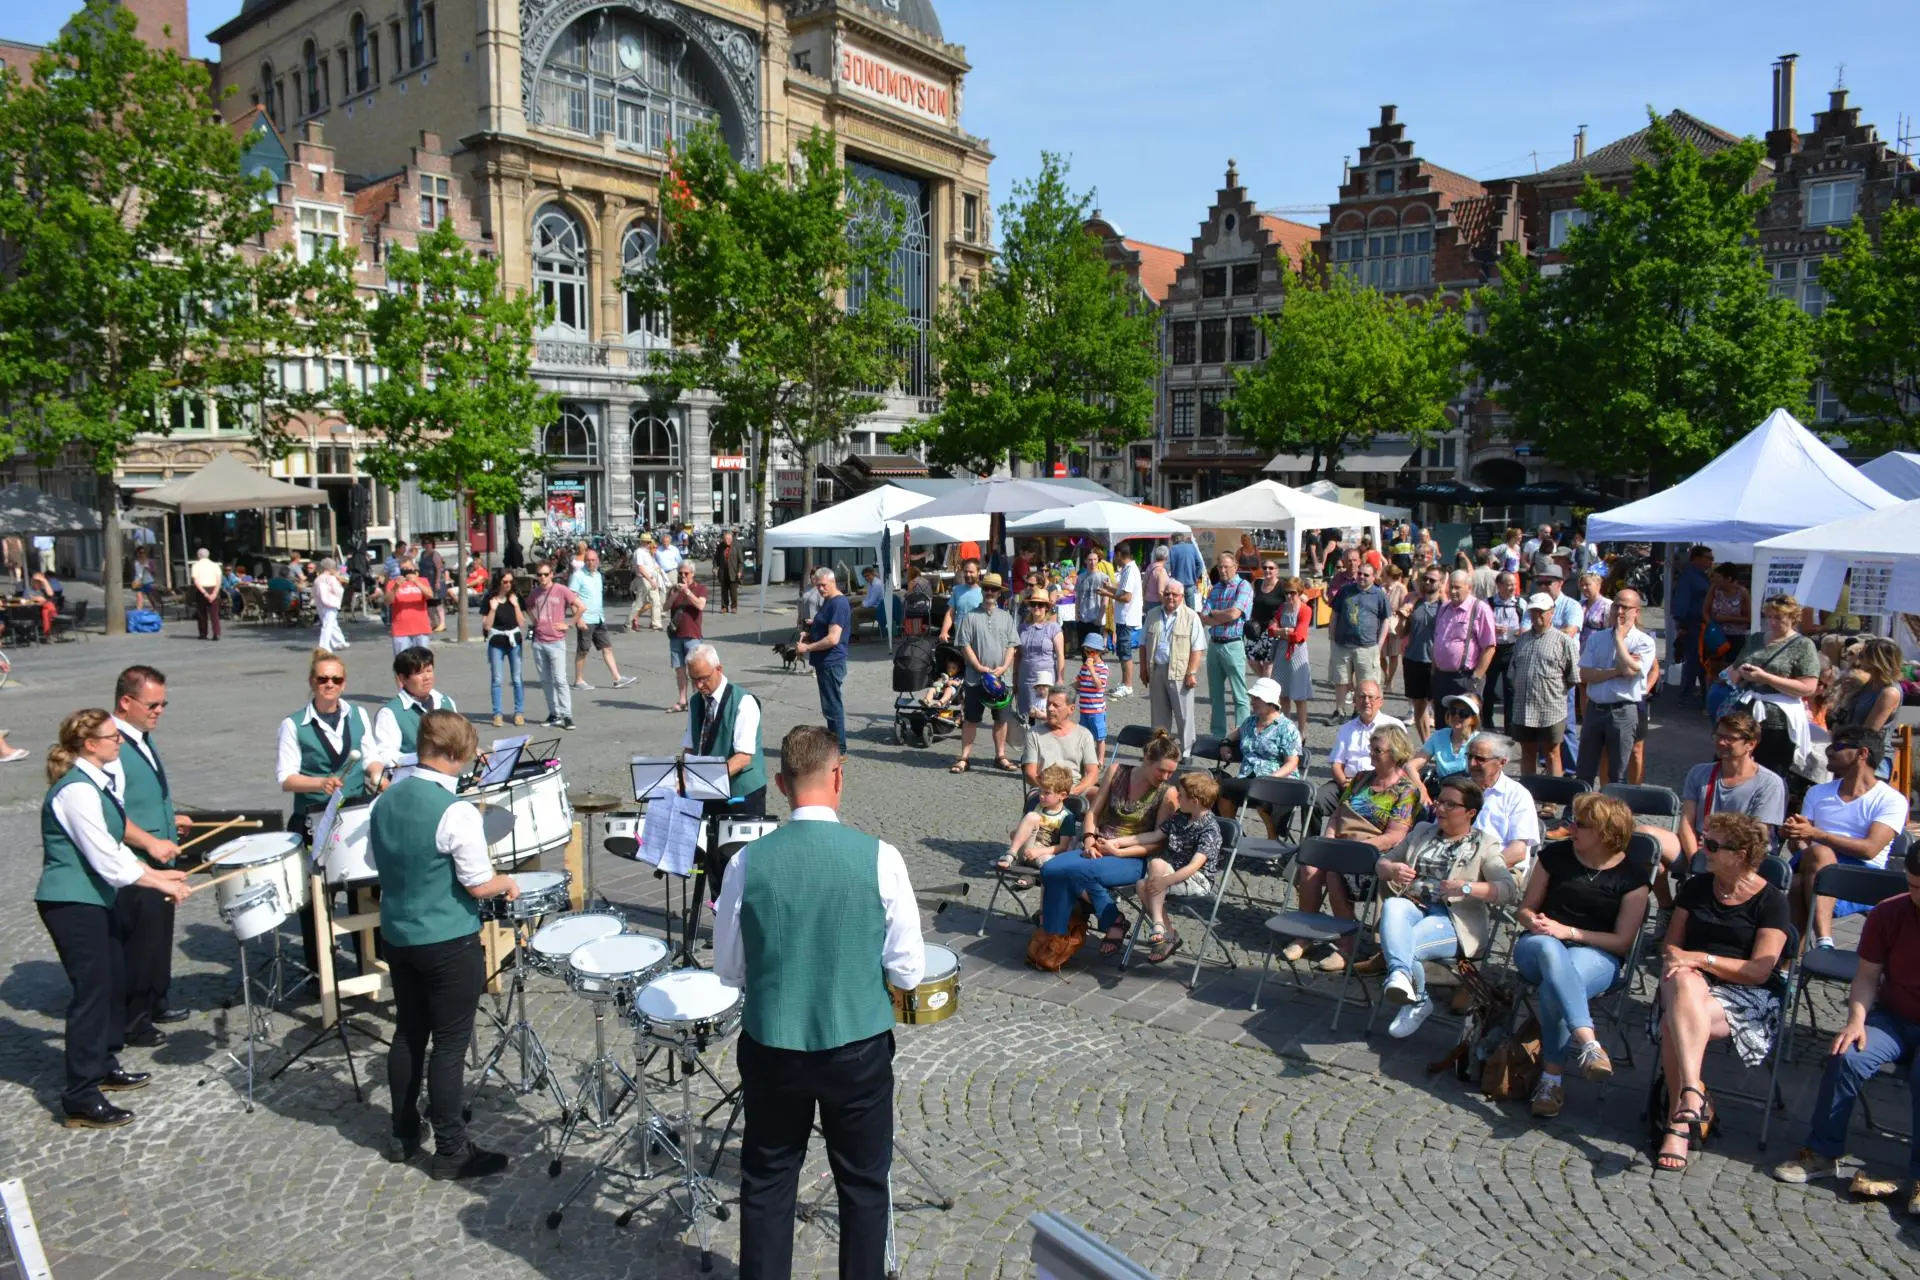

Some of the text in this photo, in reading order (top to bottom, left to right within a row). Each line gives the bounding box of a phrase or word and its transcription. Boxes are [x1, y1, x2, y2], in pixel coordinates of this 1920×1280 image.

[719, 458, 741, 468] ABVV
[777, 471, 802, 481] FRITU
[783, 487, 801, 496] JOZE
